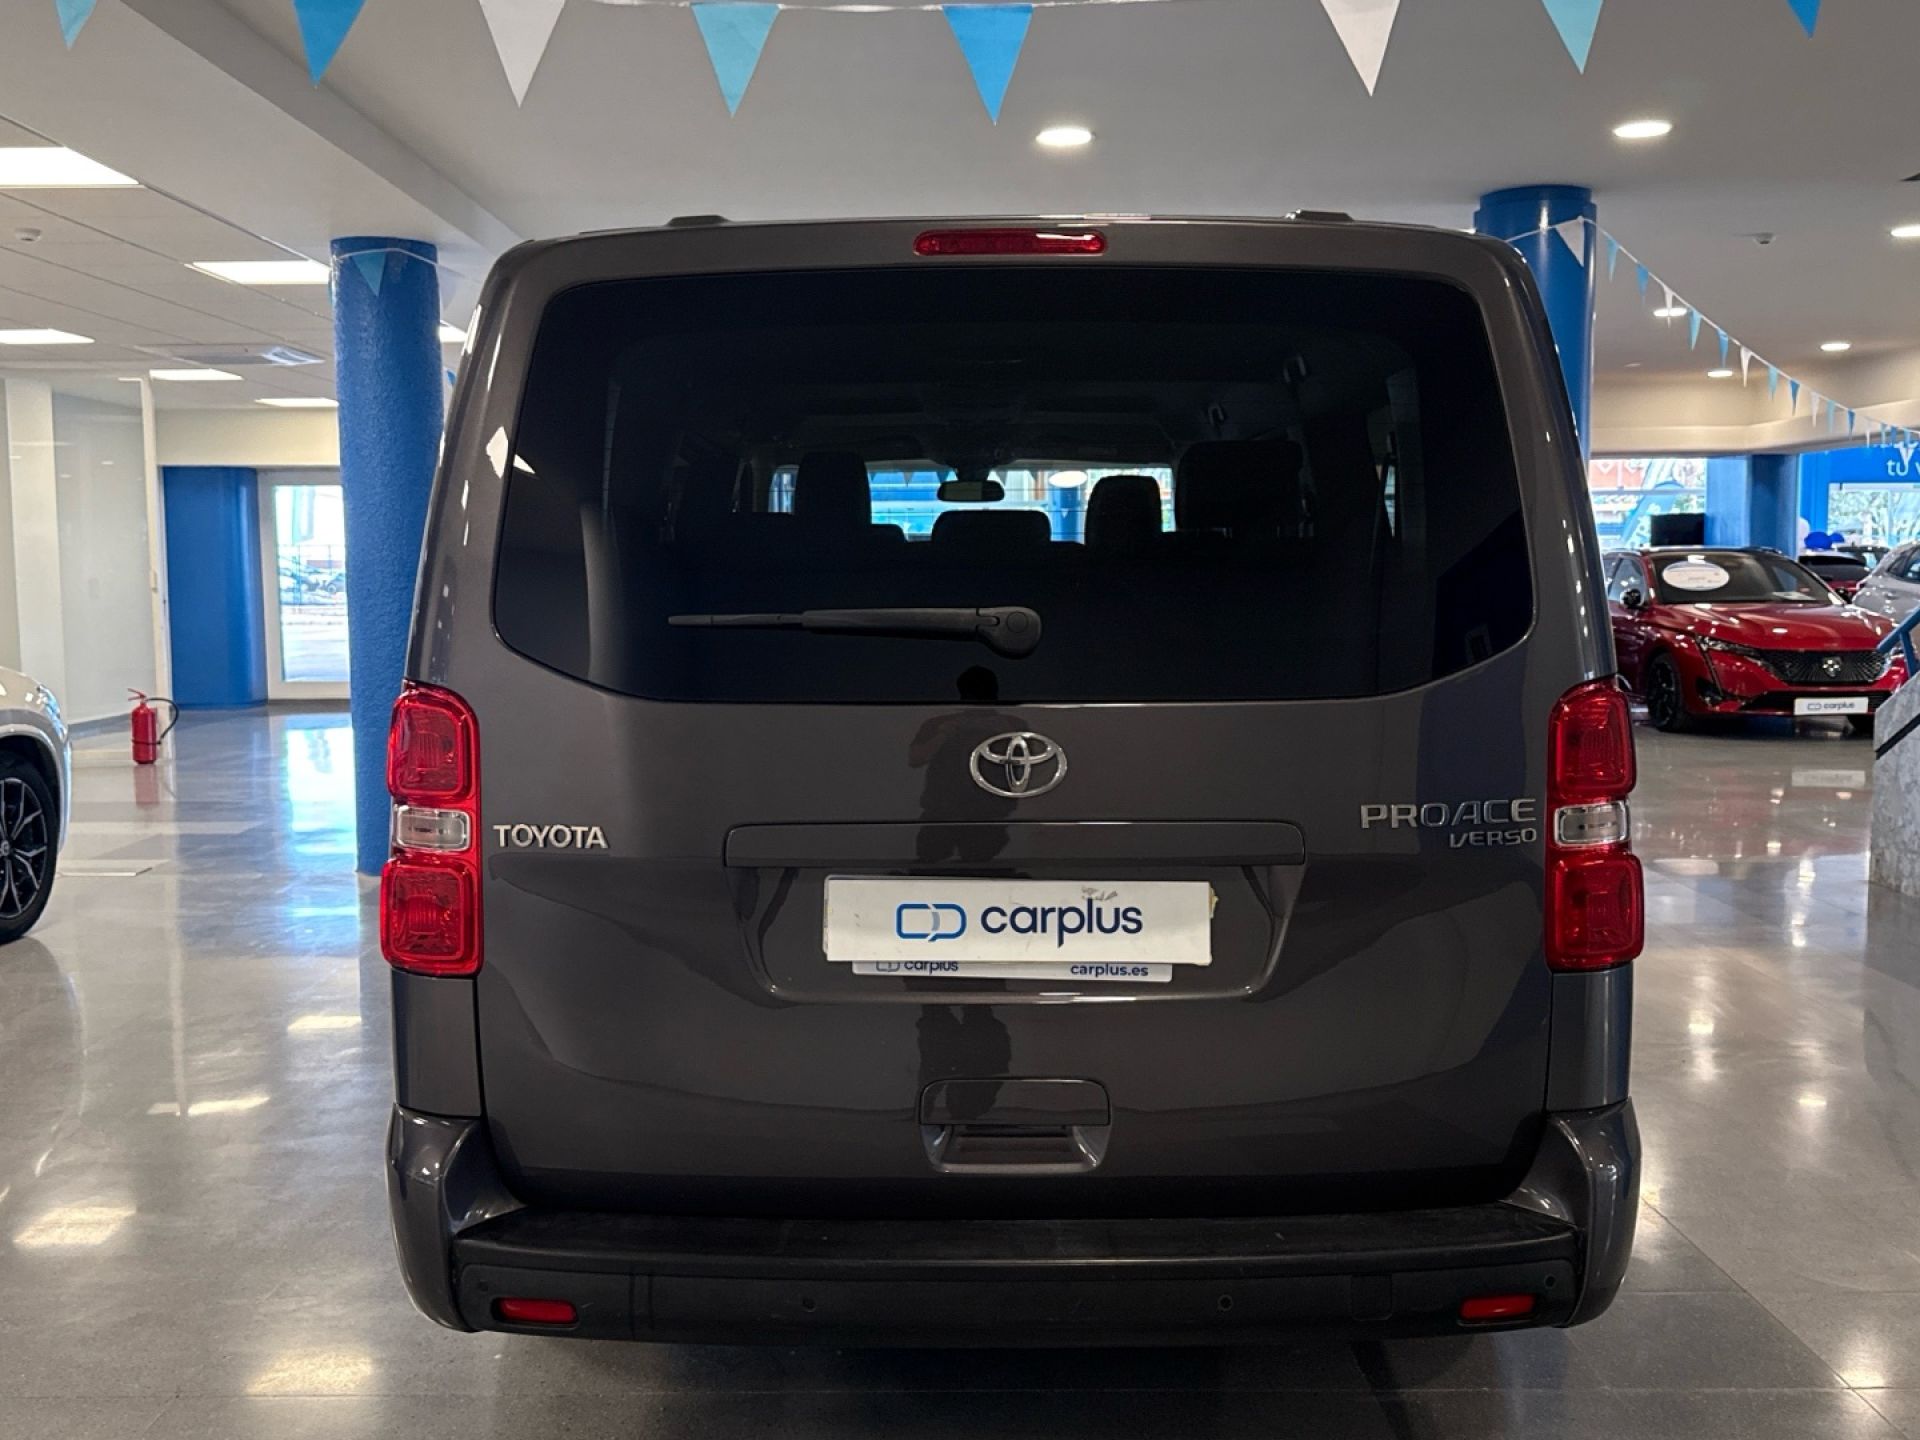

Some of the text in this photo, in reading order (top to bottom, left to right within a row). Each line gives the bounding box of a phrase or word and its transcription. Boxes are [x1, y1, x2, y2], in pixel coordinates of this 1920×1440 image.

[1823, 701, 1855, 711] carplus
[1360, 798, 1537, 829] PROACE
[493, 823, 609, 849] TOYOTA
[1449, 828, 1537, 848] VERSO
[981, 897, 1143, 948] carplus
[1070, 963, 1149, 977] carplus.es
